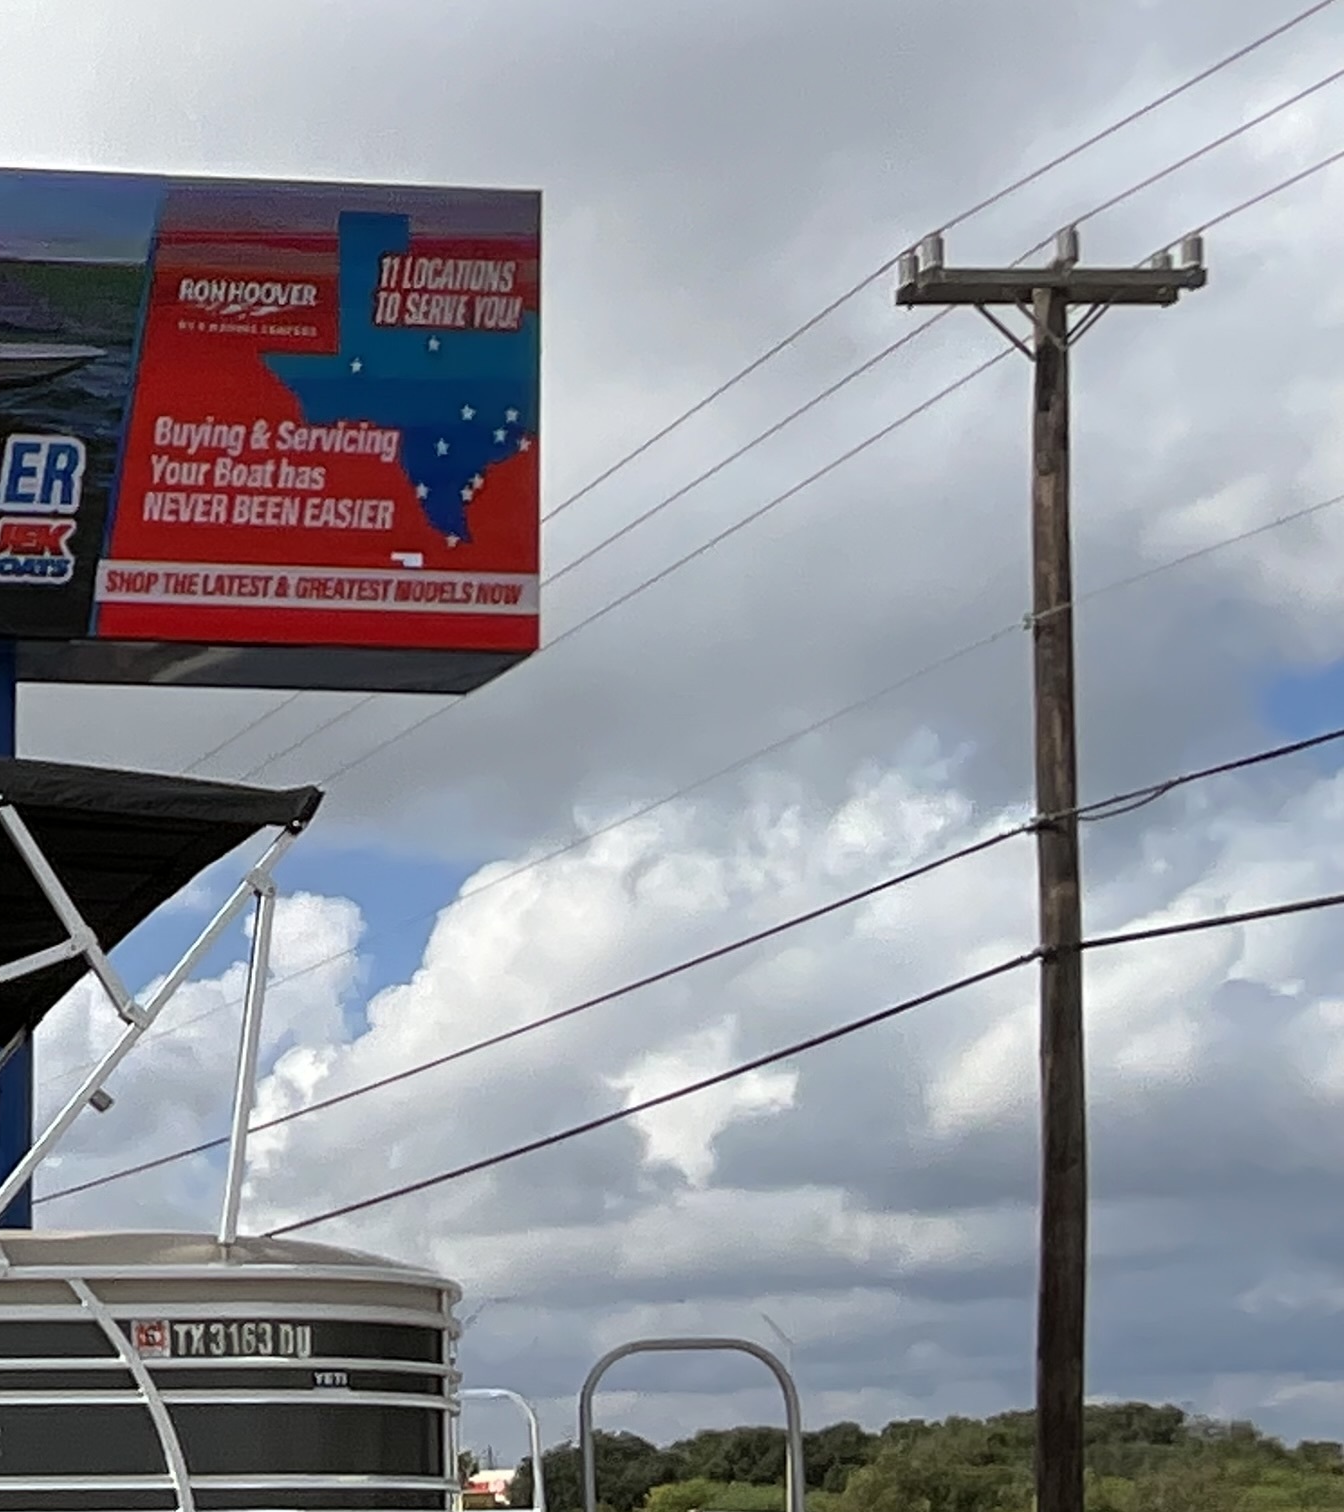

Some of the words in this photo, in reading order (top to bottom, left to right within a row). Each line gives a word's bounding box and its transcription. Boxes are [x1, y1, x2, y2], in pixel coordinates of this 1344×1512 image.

[179, 278, 226, 301] RON
[227, 280, 318, 307] HOOVER
[381, 256, 396, 289] 11
[402, 256, 516, 294] LOCATIONS
[376, 291, 397, 325] TO
[404, 293, 468, 328] SERVE
[473, 297, 524, 330] YOU!
[154, 415, 244, 456] Buying
[249, 420, 270, 448] &
[276, 421, 401, 462] Servicing
[150, 454, 207, 486] Your
[214, 457, 275, 489] Boat
[278, 460, 327, 491] has
[142, 491, 229, 524] NEVER
[232, 494, 299, 527] BEEN
[304, 496, 396, 530] EASIER
[105, 570, 160, 595] SHOP
[163, 571, 199, 596] THE
[201, 573, 274, 598] LATEST
[275, 576, 288, 598] &
[296, 576, 392, 602] GREATEST
[395, 579, 474, 605] MODELS
[475, 582, 523, 606] NOW
[173, 1322, 206, 1356] TX
[209, 1322, 273, 1356] 3163
[278, 1323, 312, 1359] DU
[314, 1371, 349, 1387] YETI
